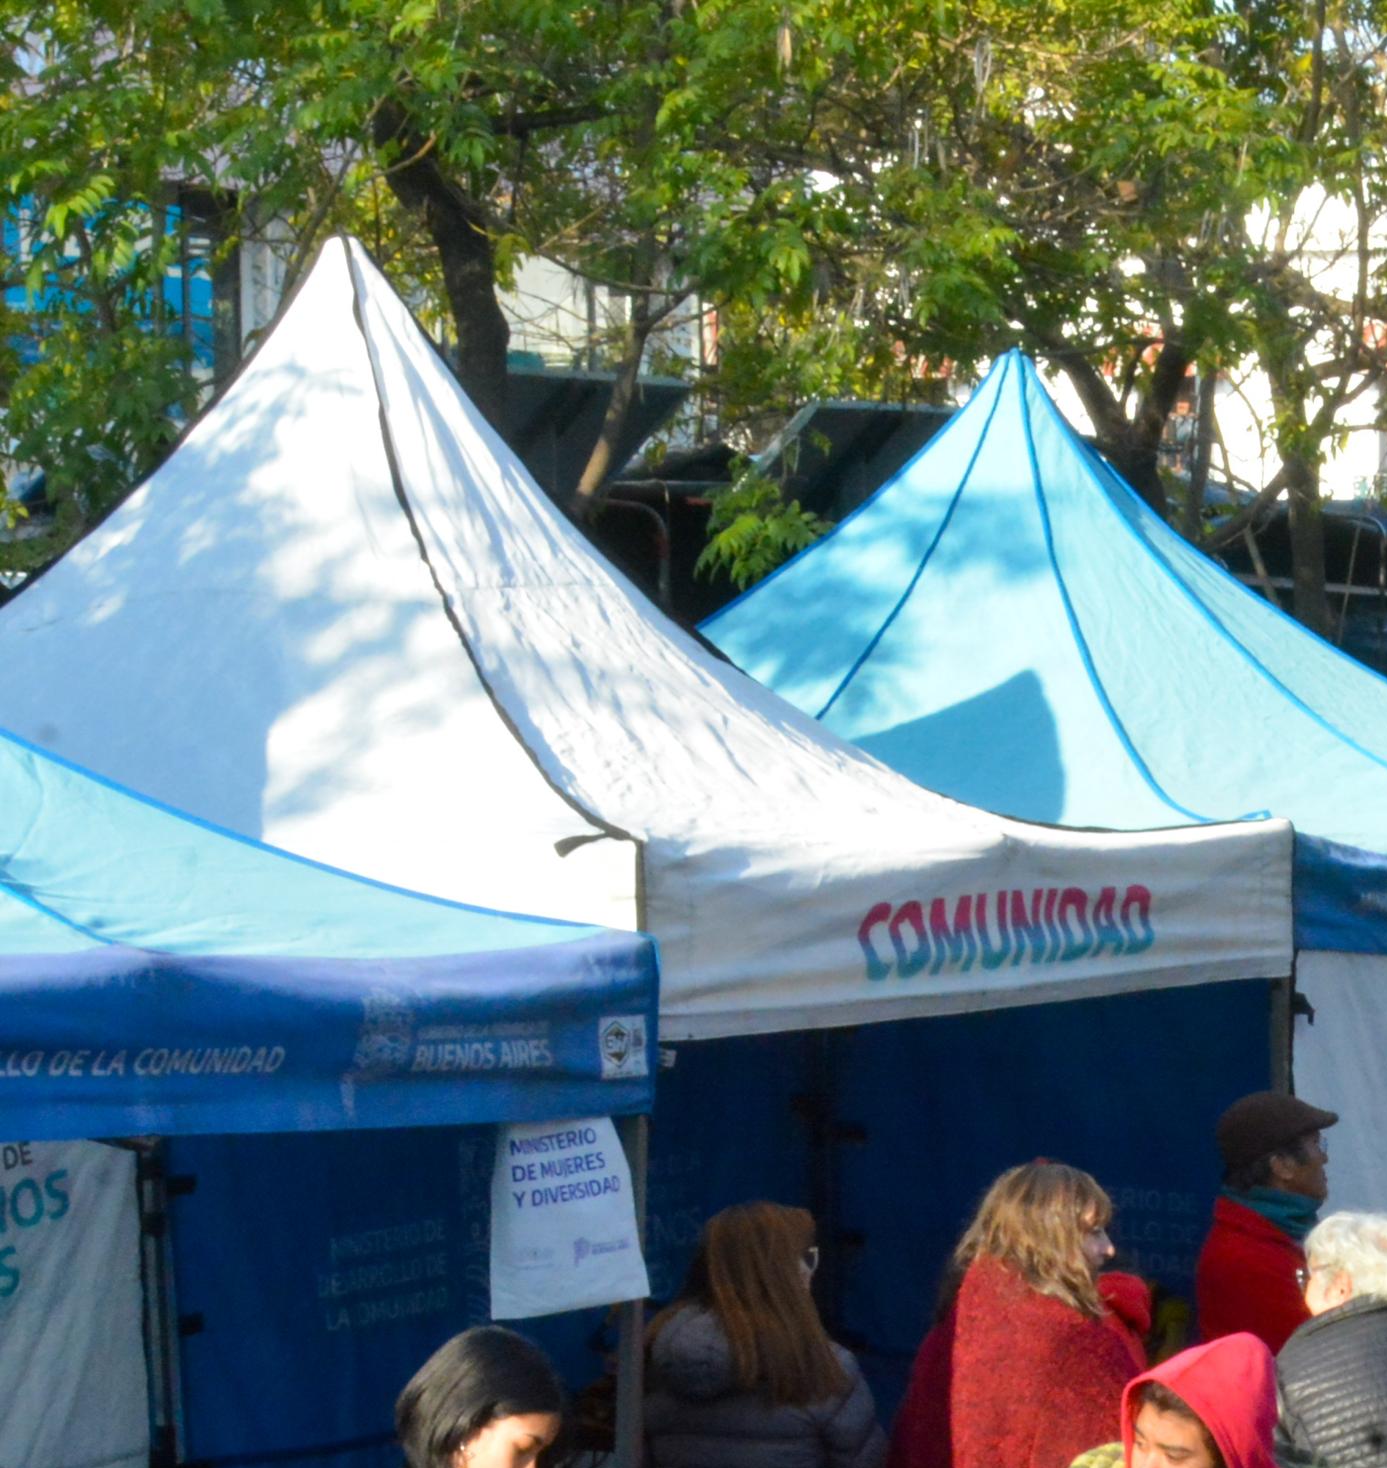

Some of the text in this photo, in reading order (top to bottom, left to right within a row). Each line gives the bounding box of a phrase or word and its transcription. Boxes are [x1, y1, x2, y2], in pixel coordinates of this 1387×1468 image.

[858, 884, 1155, 982] COMUNIDAD
[49, 1050, 90, 1077] DE
[91, 1050, 125, 1077] LA
[133, 1045, 286, 1076] COMUNIDAD
[411, 1038, 553, 1072] BUENOS AIRES
[510, 1127, 598, 1157] MINISTERIO
[512, 1151, 606, 1183] DE MUJERES
[512, 1191, 526, 1209] Y
[531, 1175, 621, 1207] DIVERSIDAD
